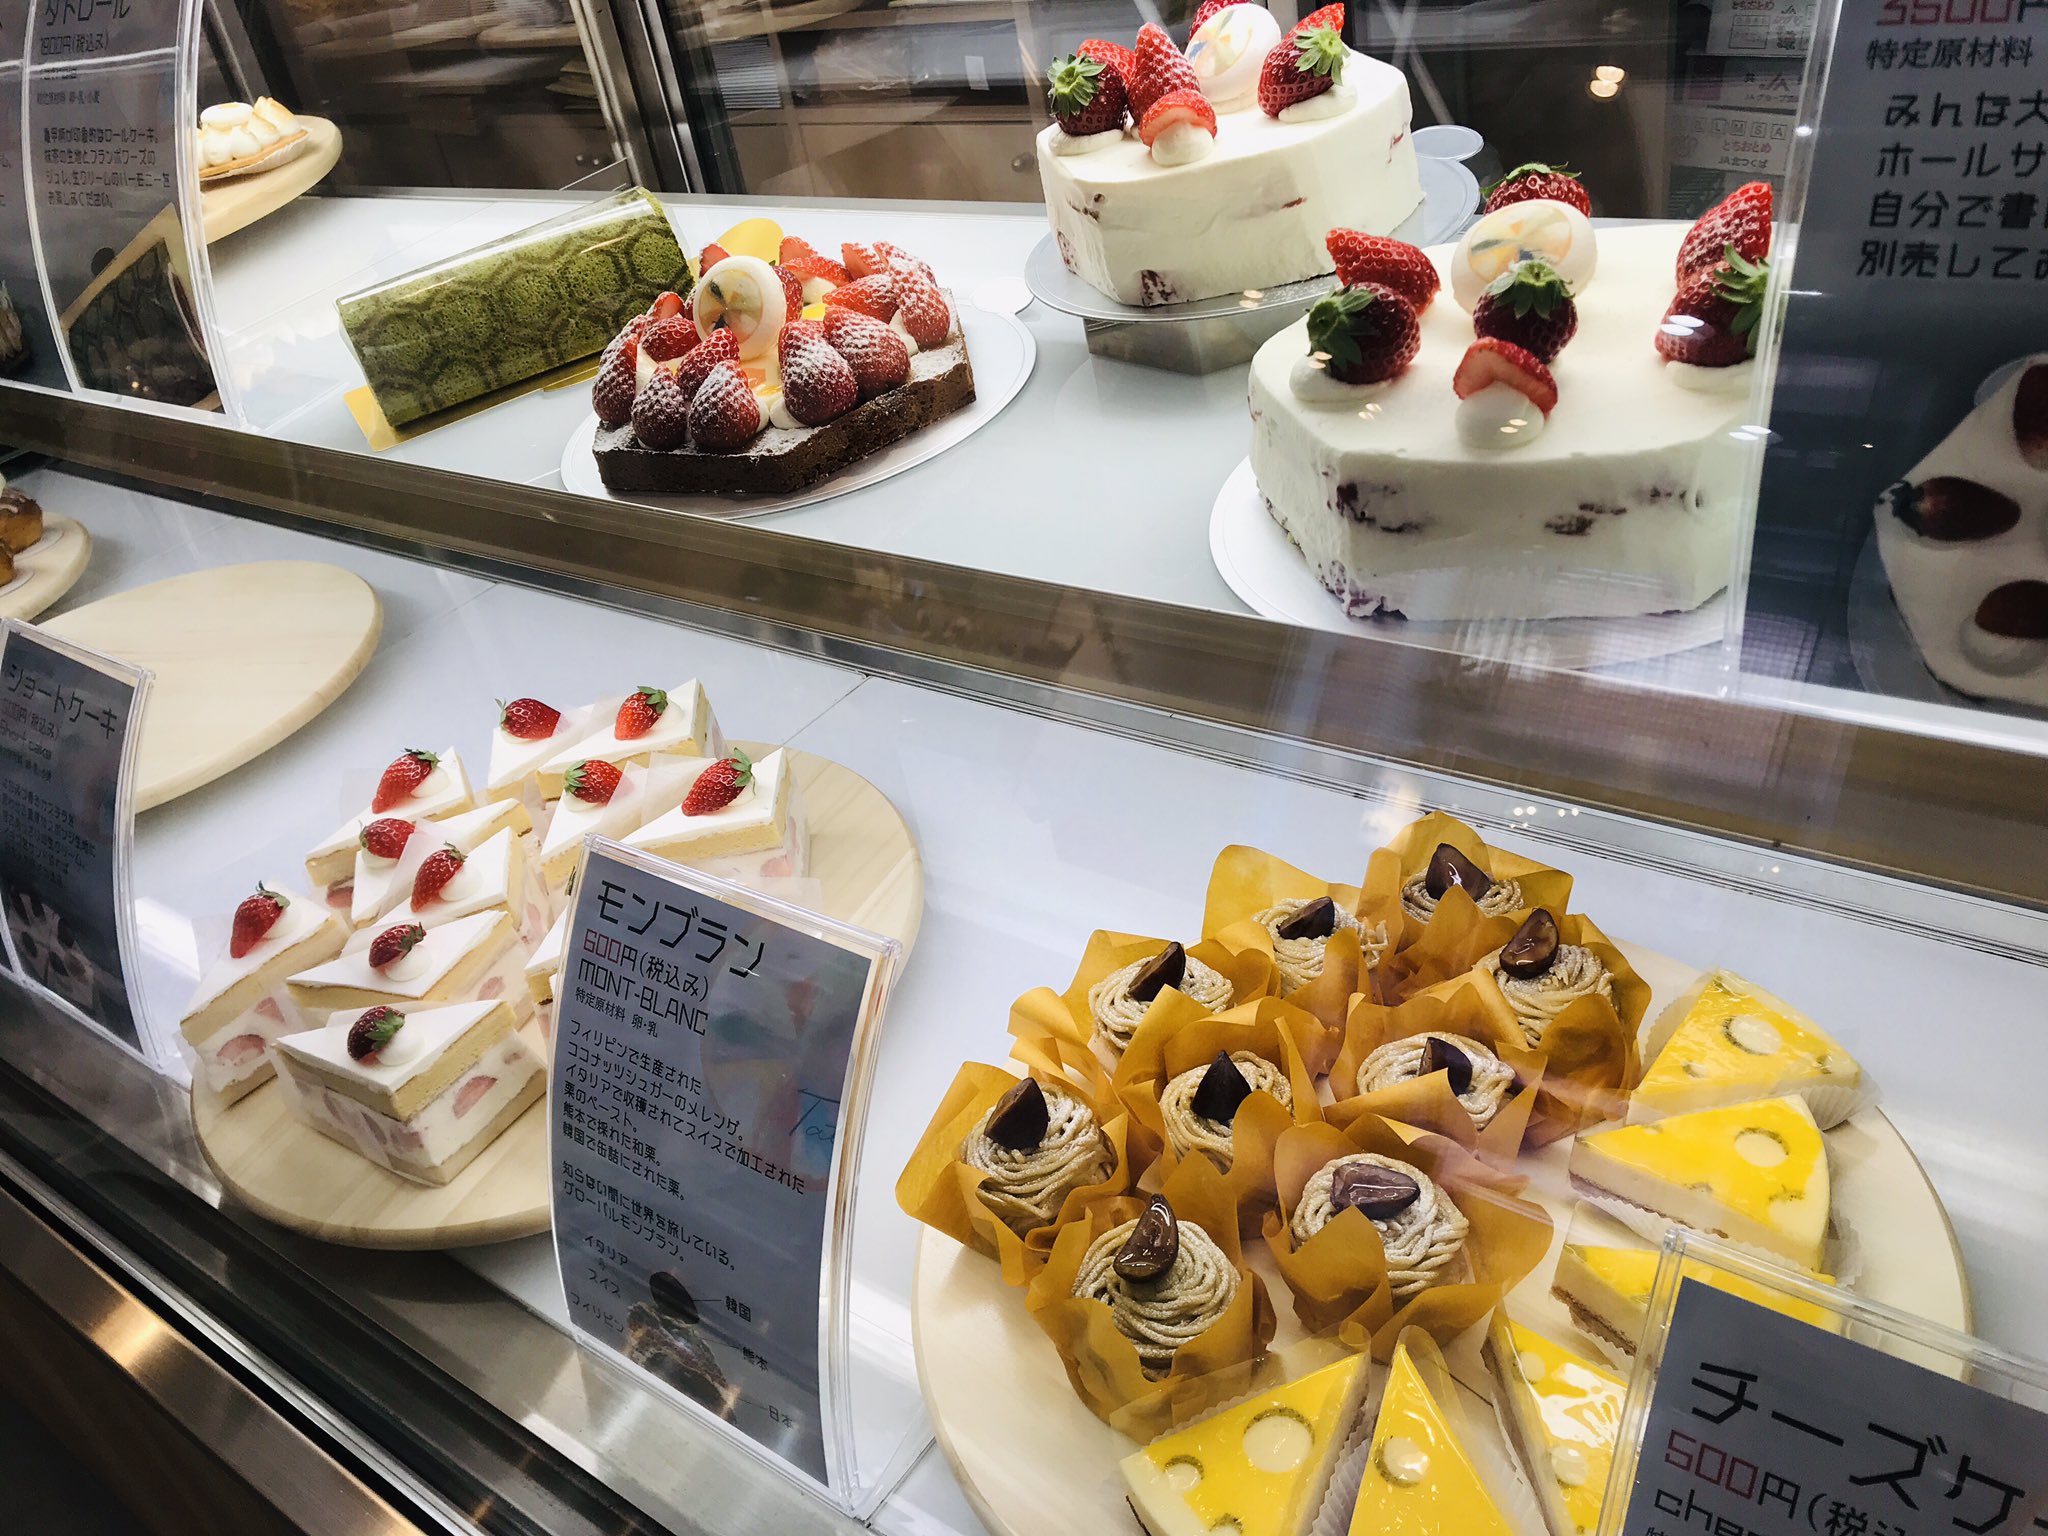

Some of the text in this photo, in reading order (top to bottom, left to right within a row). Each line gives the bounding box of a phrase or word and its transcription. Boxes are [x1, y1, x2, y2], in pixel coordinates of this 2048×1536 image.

[1866, 35, 2033, 70] 特定原材料
[1869, 187, 2048, 229] 自分で書
[8, 663, 118, 740] ショートケーキ
[583, 928, 709, 1003] 600円(税込み)
[597, 879, 765, 978] モンブラン
[575, 986, 626, 1023] 特定原材料
[578, 958, 709, 1037] MONT-BLANC
[567, 1041, 743, 1142] ココナッツシュガーのメレンゲ。
[570, 1019, 702, 1096] フィリピンで生産された
[563, 1080, 637, 1133] 栗のペースト。
[565, 1063, 805, 1196] イタリアで収穫されてスイスで加工された
[562, 1121, 686, 1202] 韓国で缶詰にされた栗。
[561, 1160, 736, 1271] 知らない間に世界を旅している。
[584, 1235, 628, 1265] イタリア
[588, 1268, 622, 1299] スイス
[725, 1295, 751, 1323] 韓国
[768, 1405, 795, 1429] 日本
[1691, 1362, 2048, 1534] チーズケ
